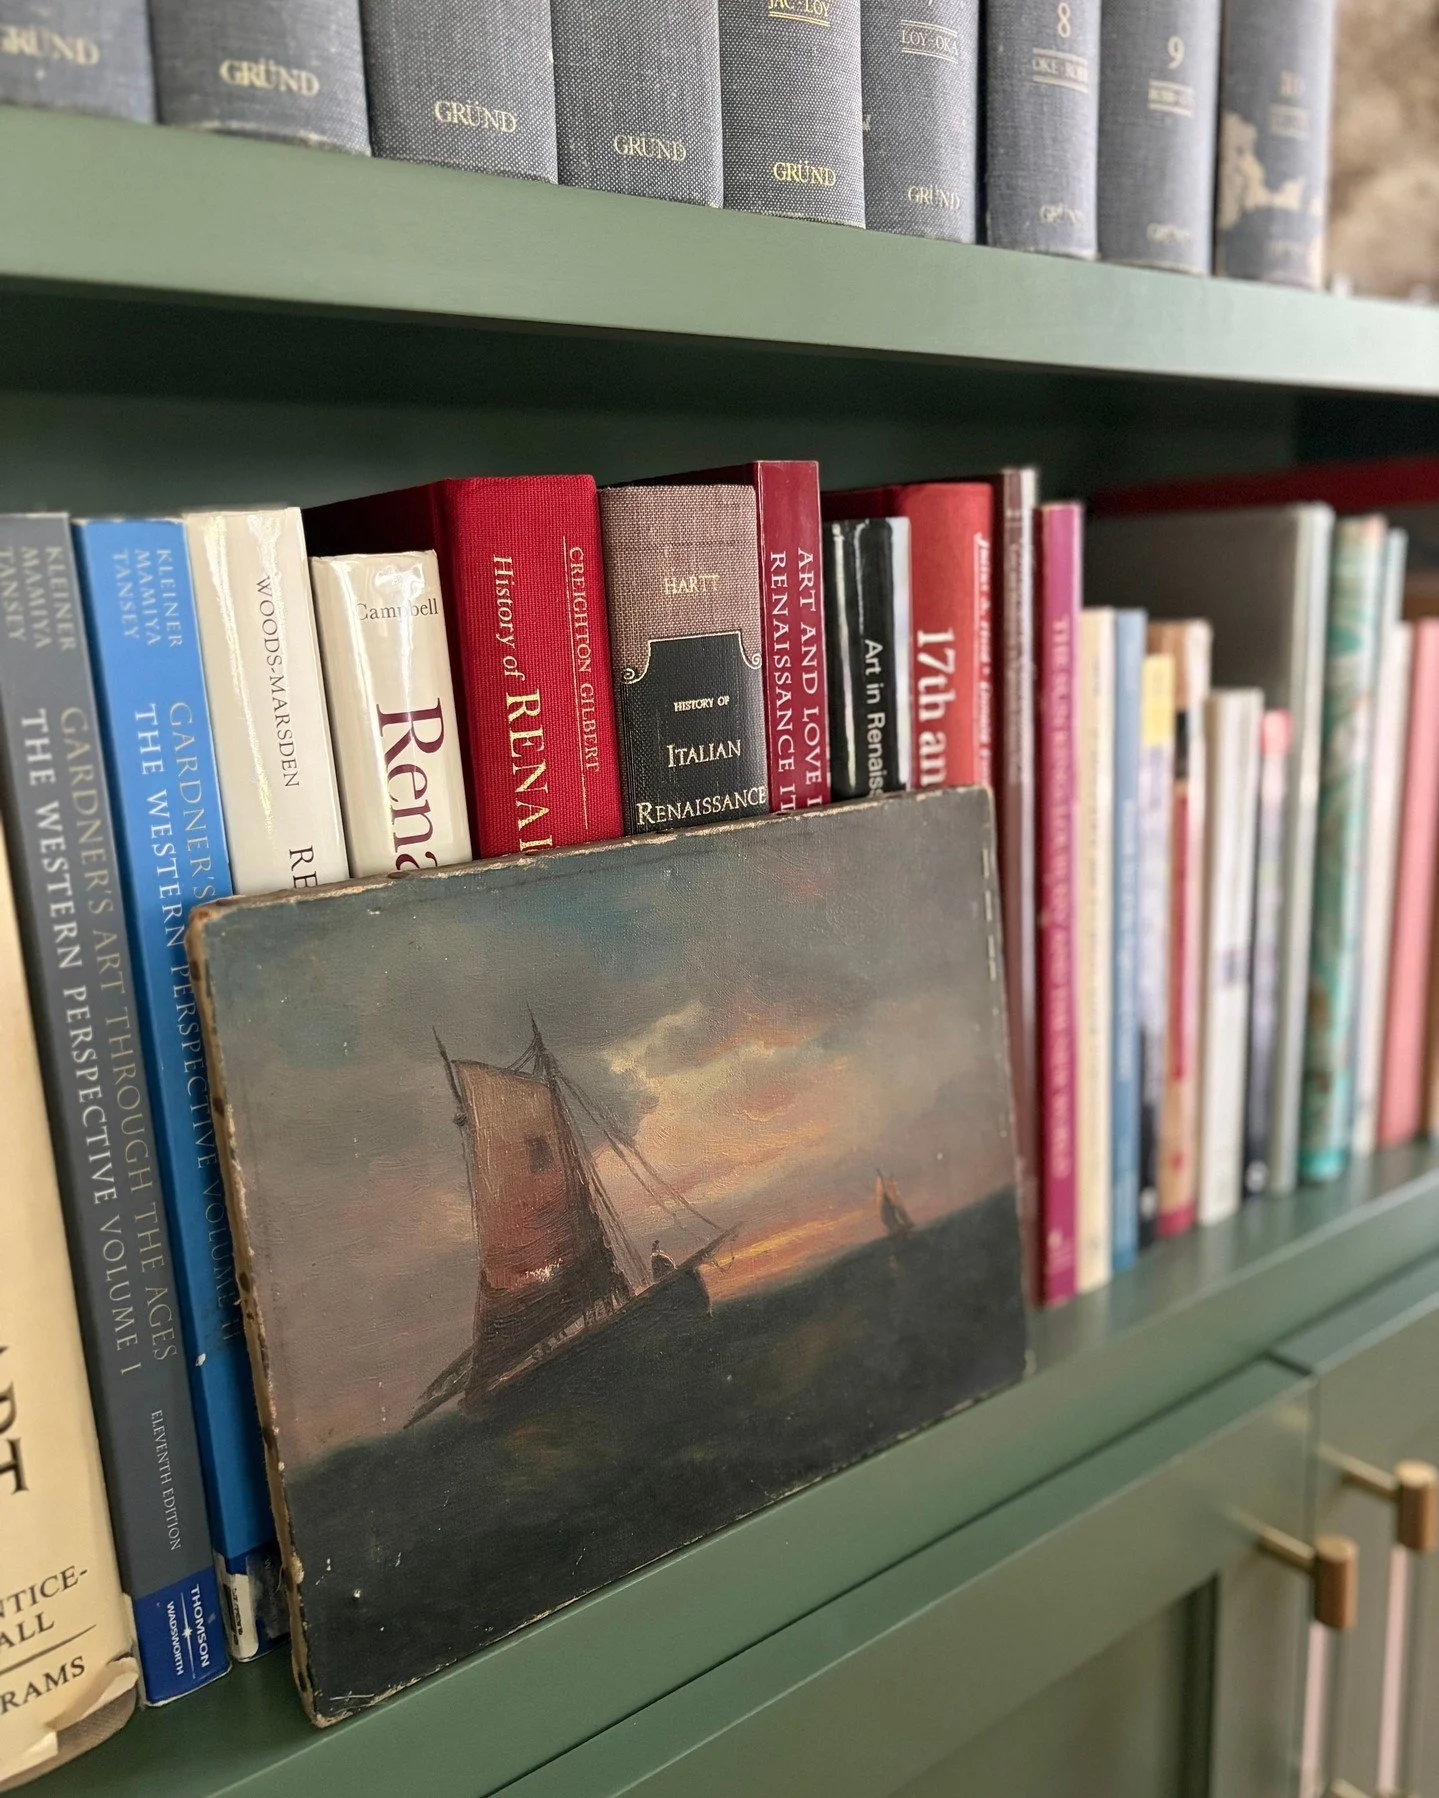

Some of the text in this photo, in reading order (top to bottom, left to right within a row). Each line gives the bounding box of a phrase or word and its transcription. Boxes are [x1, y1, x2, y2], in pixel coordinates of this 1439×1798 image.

[1057, 3, 1071, 38] 8
[1167, 36, 1185, 69] 9
[219, 58, 321, 97] GRÜND
[434, 98, 518, 134] GRÜND
[612, 132, 687, 163] GRÜND
[772, 160, 837, 187] GRÜND
[906, 185, 961, 211] GRÜND
[0, 545, 27, 643] TANSEY
[20, 545, 53, 650] MAMIYA
[45, 546, 77, 652] KLEINER
[112, 548, 140, 639] TANSEY
[135, 548, 162, 646] MAMIYA
[157, 548, 183, 647] KLEINER
[355, 598, 439, 622] Campbell
[493, 554, 517, 650] History
[664, 574, 720, 595] HARTT
[798, 547, 817, 612] ART
[257, 575, 300, 788] WOODS-MARSDEN
[503, 657, 526, 681] of
[569, 546, 600, 772] CREIGHTON GILBERT
[770, 551, 796, 772] RENAISSANCE
[800, 622, 819, 694] AND
[864, 639, 883, 676] Art
[866, 683, 884, 704] in
[916, 627, 956, 722] 17th
[135, 703, 165, 776] THE
[674, 695, 731, 712] HISTORY OF
[667, 740, 742, 768] ITALIAN
[802, 706, 823, 785] LOVE
[169, 702, 216, 899] GARDNER'S
[636, 786, 767, 826] RENAISSANCE
[147, 789, 185, 949] WESTERN
[21, 707, 142, 1376] THE WESTERN PERSPECTIVE VOLUME I
[60, 706, 178, 1361] GARDNER'S ART THROUGH THE AGES
[171, 964, 217, 1169] PERSPECTIVE
[203, 1179, 235, 1308] VOLUME
[151, 1409, 182, 1551] ELEVENTH EDITION
[166, 1600, 185, 1676] WADSWORTH
[190, 1584, 210, 1668] THOMSON
[0, 1656, 86, 1715] RAMS
